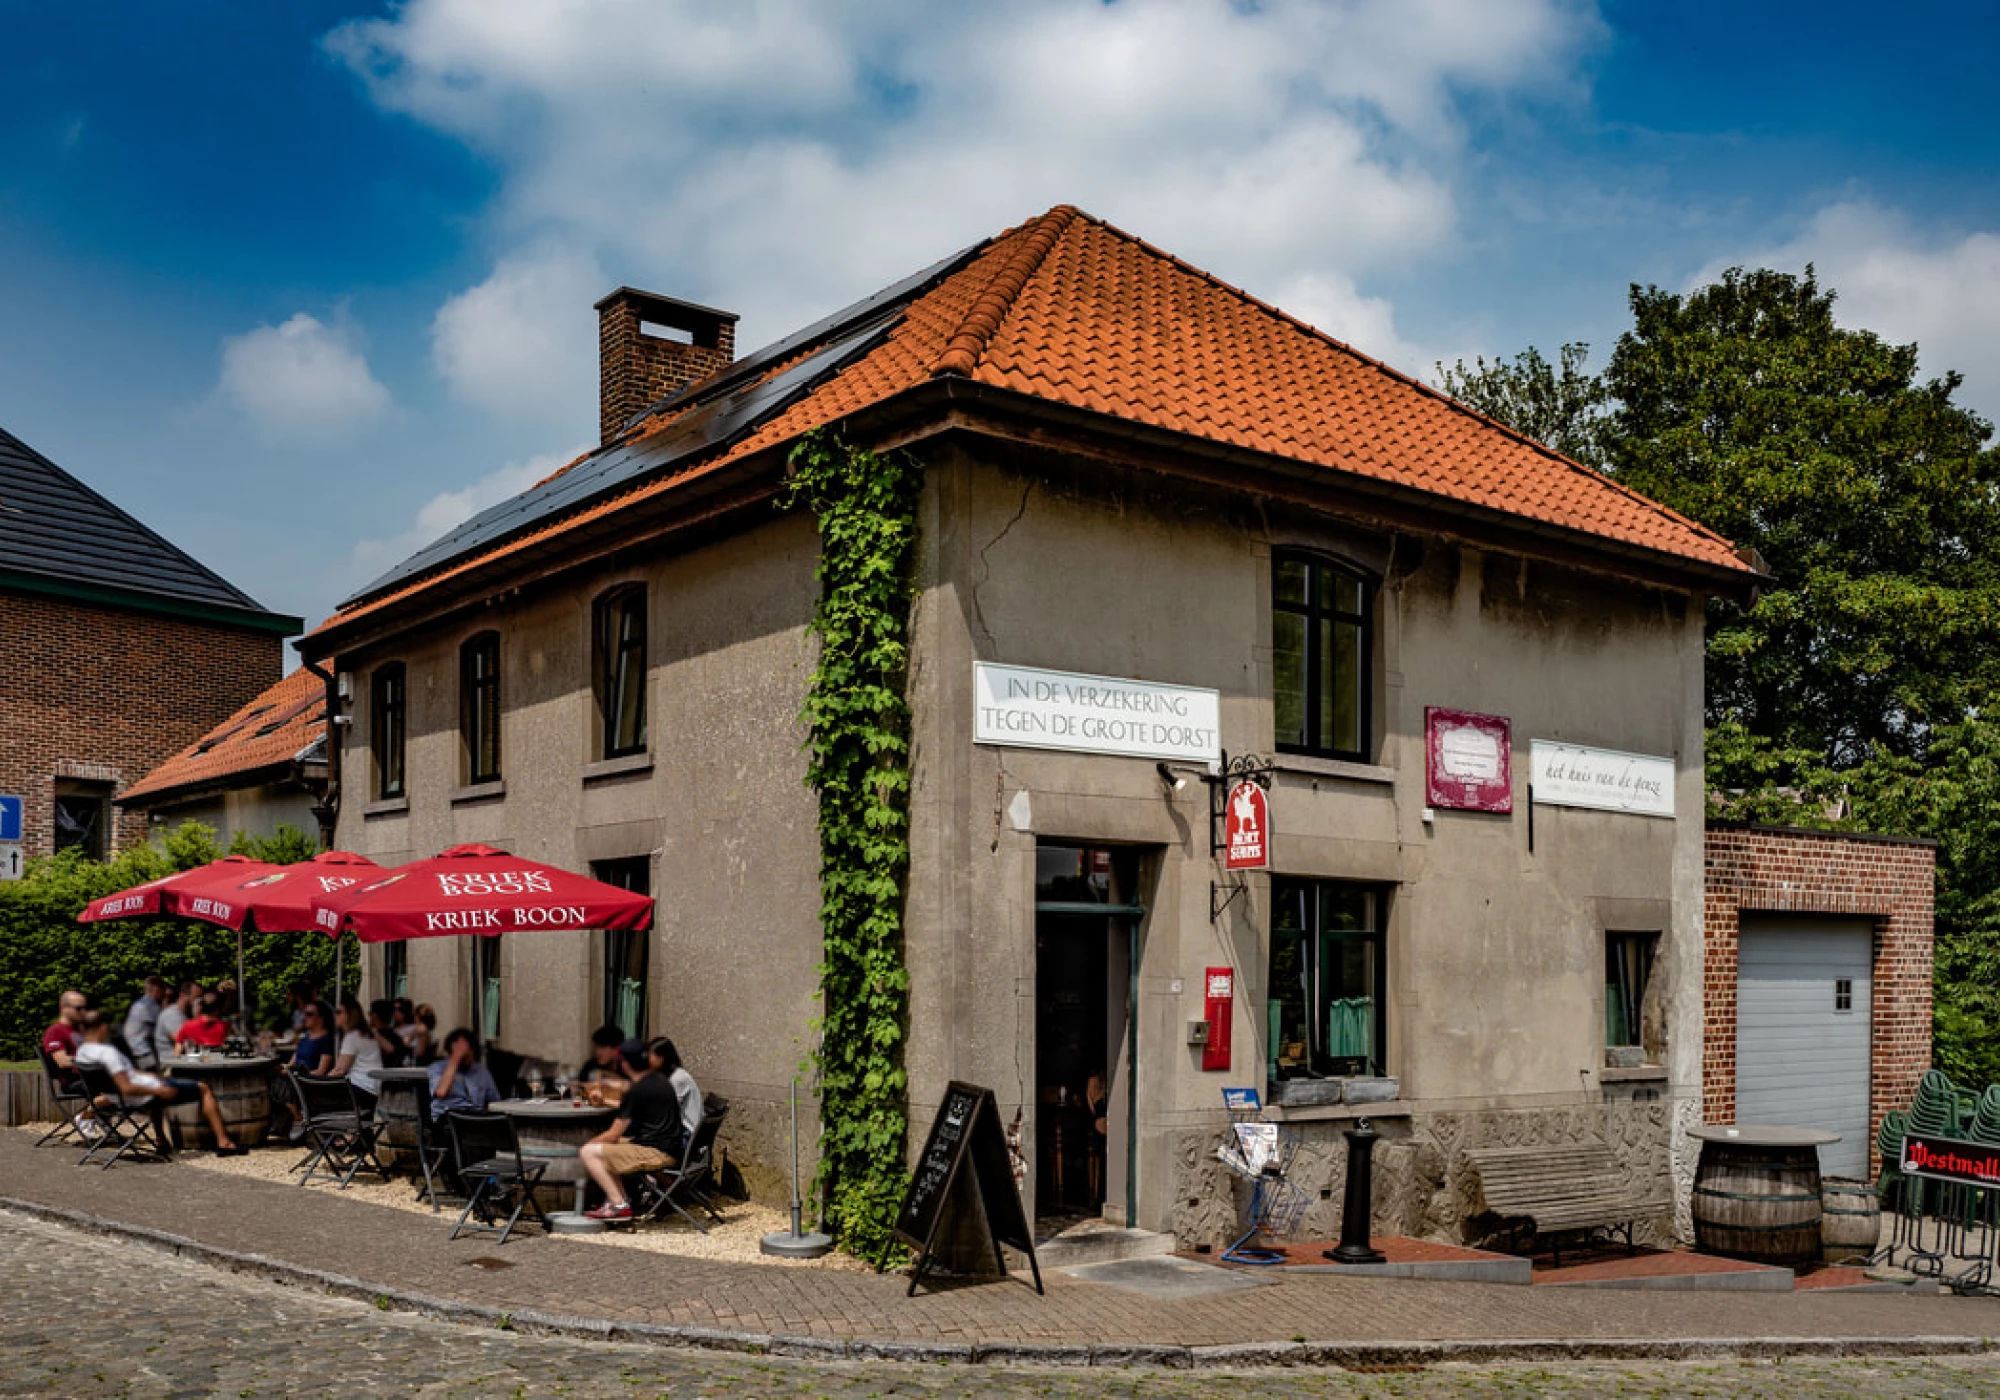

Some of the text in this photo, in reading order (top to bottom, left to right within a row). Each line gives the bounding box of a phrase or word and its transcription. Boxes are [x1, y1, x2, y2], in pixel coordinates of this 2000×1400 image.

[1008, 677, 1188, 717] IN DE VERZEKERING
[981, 706, 1216, 748] TEGEN DE GROTE DORST
[436, 870, 549, 886] KRIEK
[441, 883, 554, 896] BOON
[425, 906, 585, 930] KRIEK BOON
[1909, 1142, 2000, 1177] Westmall
